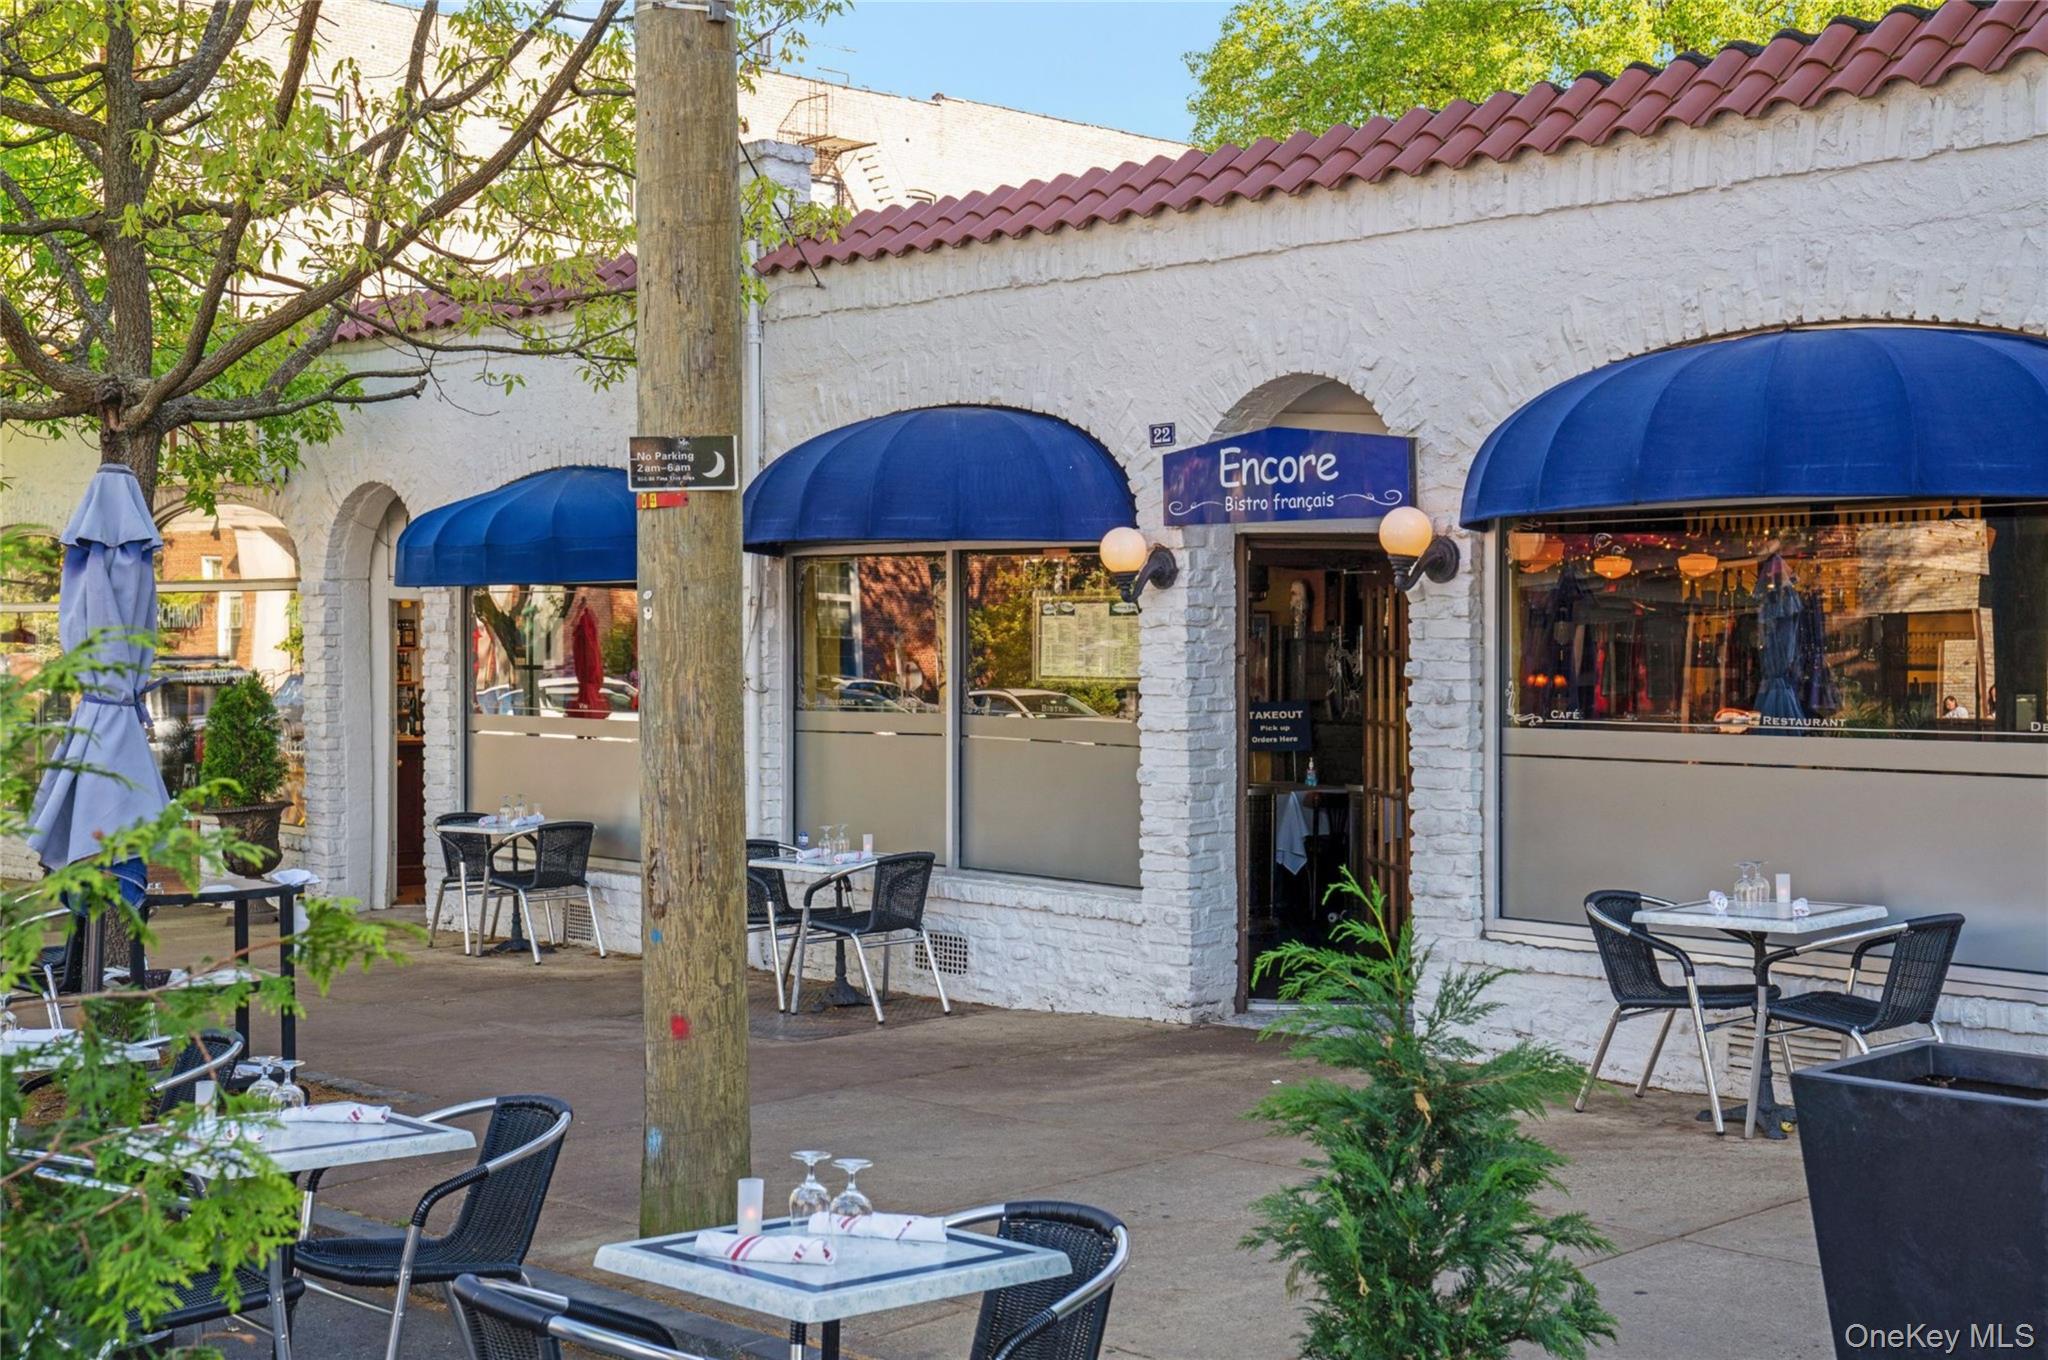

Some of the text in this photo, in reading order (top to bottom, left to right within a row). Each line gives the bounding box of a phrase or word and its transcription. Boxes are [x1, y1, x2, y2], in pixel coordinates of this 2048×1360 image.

[1153, 427, 1171, 443] 22
[636, 451, 695, 462] No Parking
[1219, 447, 1339, 488] Encore
[1225, 491, 1335, 512] Bistro français
[208, 669, 228, 684] AND
[1249, 710, 1303, 719] TAKEOUT
[1762, 716, 1847, 727] RESTAURANT
